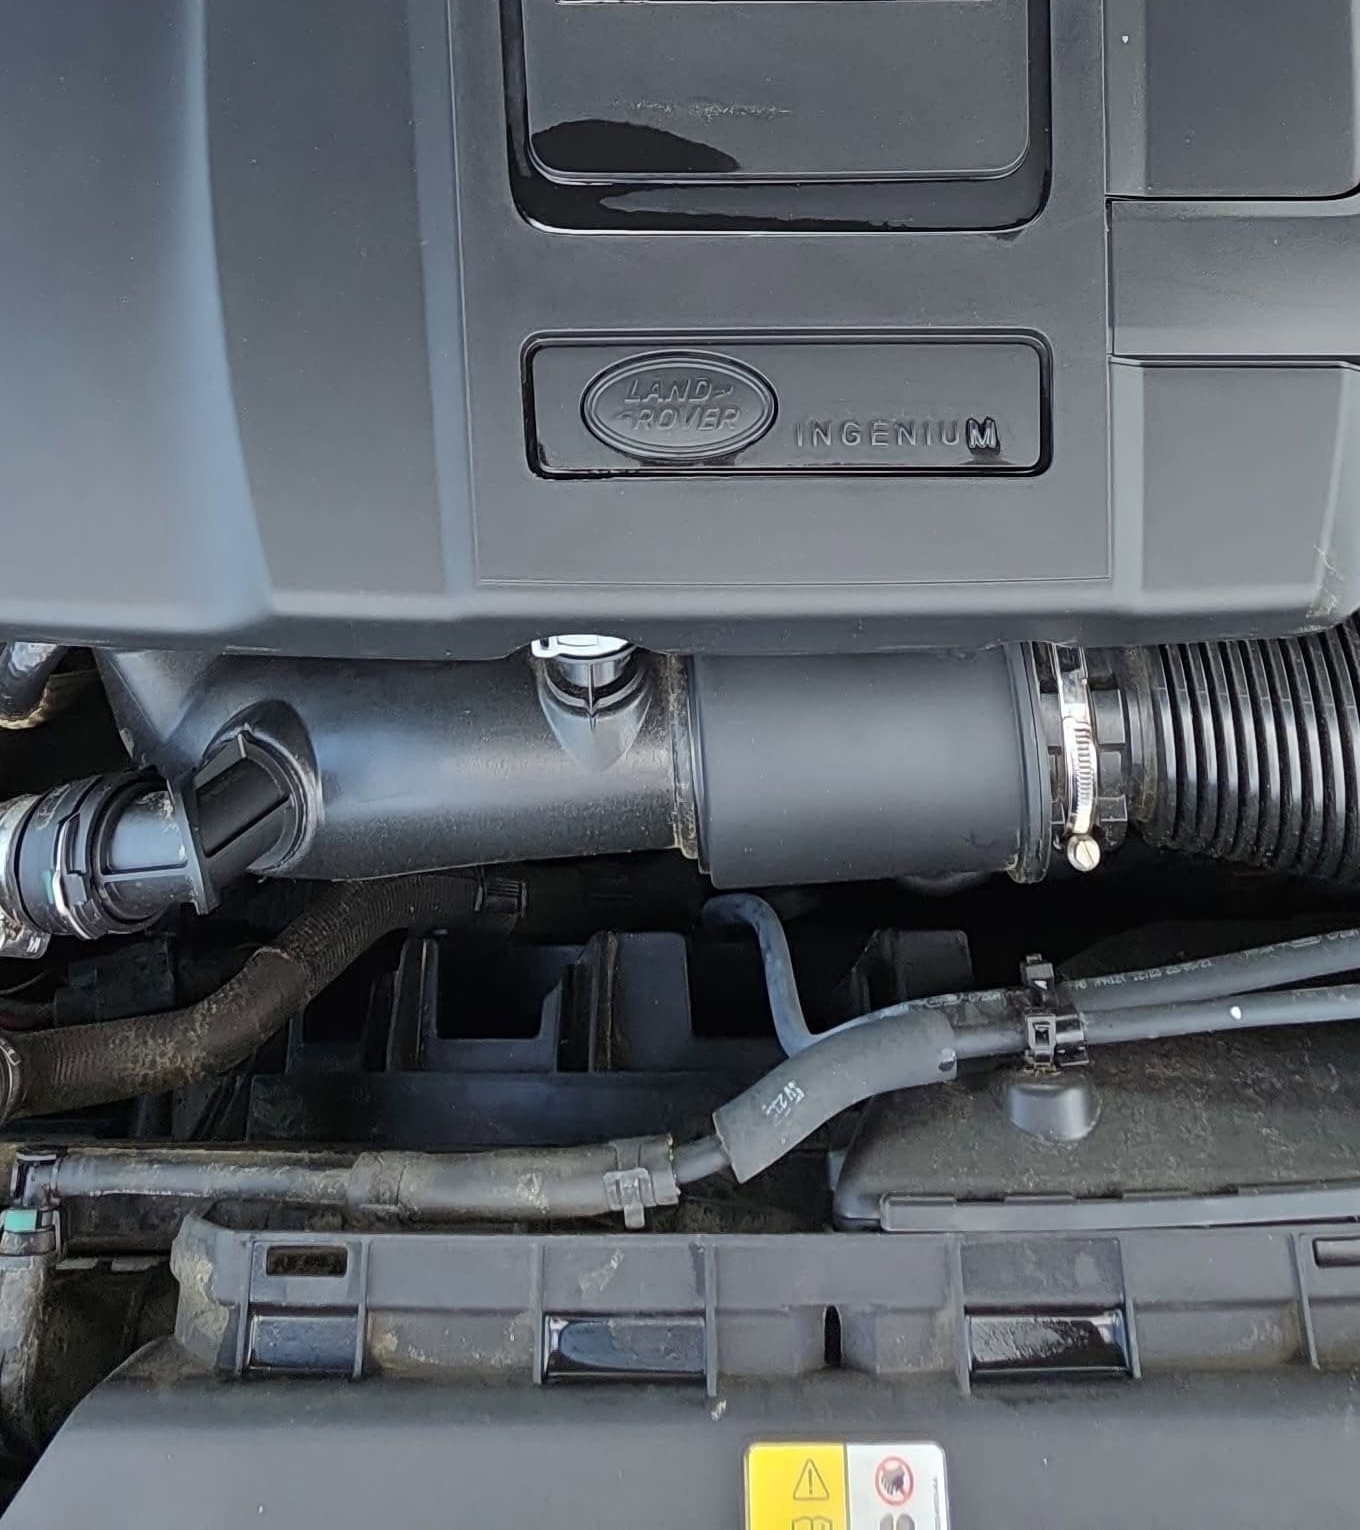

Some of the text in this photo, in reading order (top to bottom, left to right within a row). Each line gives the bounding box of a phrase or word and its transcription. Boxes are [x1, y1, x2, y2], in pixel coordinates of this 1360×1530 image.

[624, 376, 712, 403] LAND
[633, 404, 742, 431] ROVER
[794, 417, 1001, 449] INGENIUM
